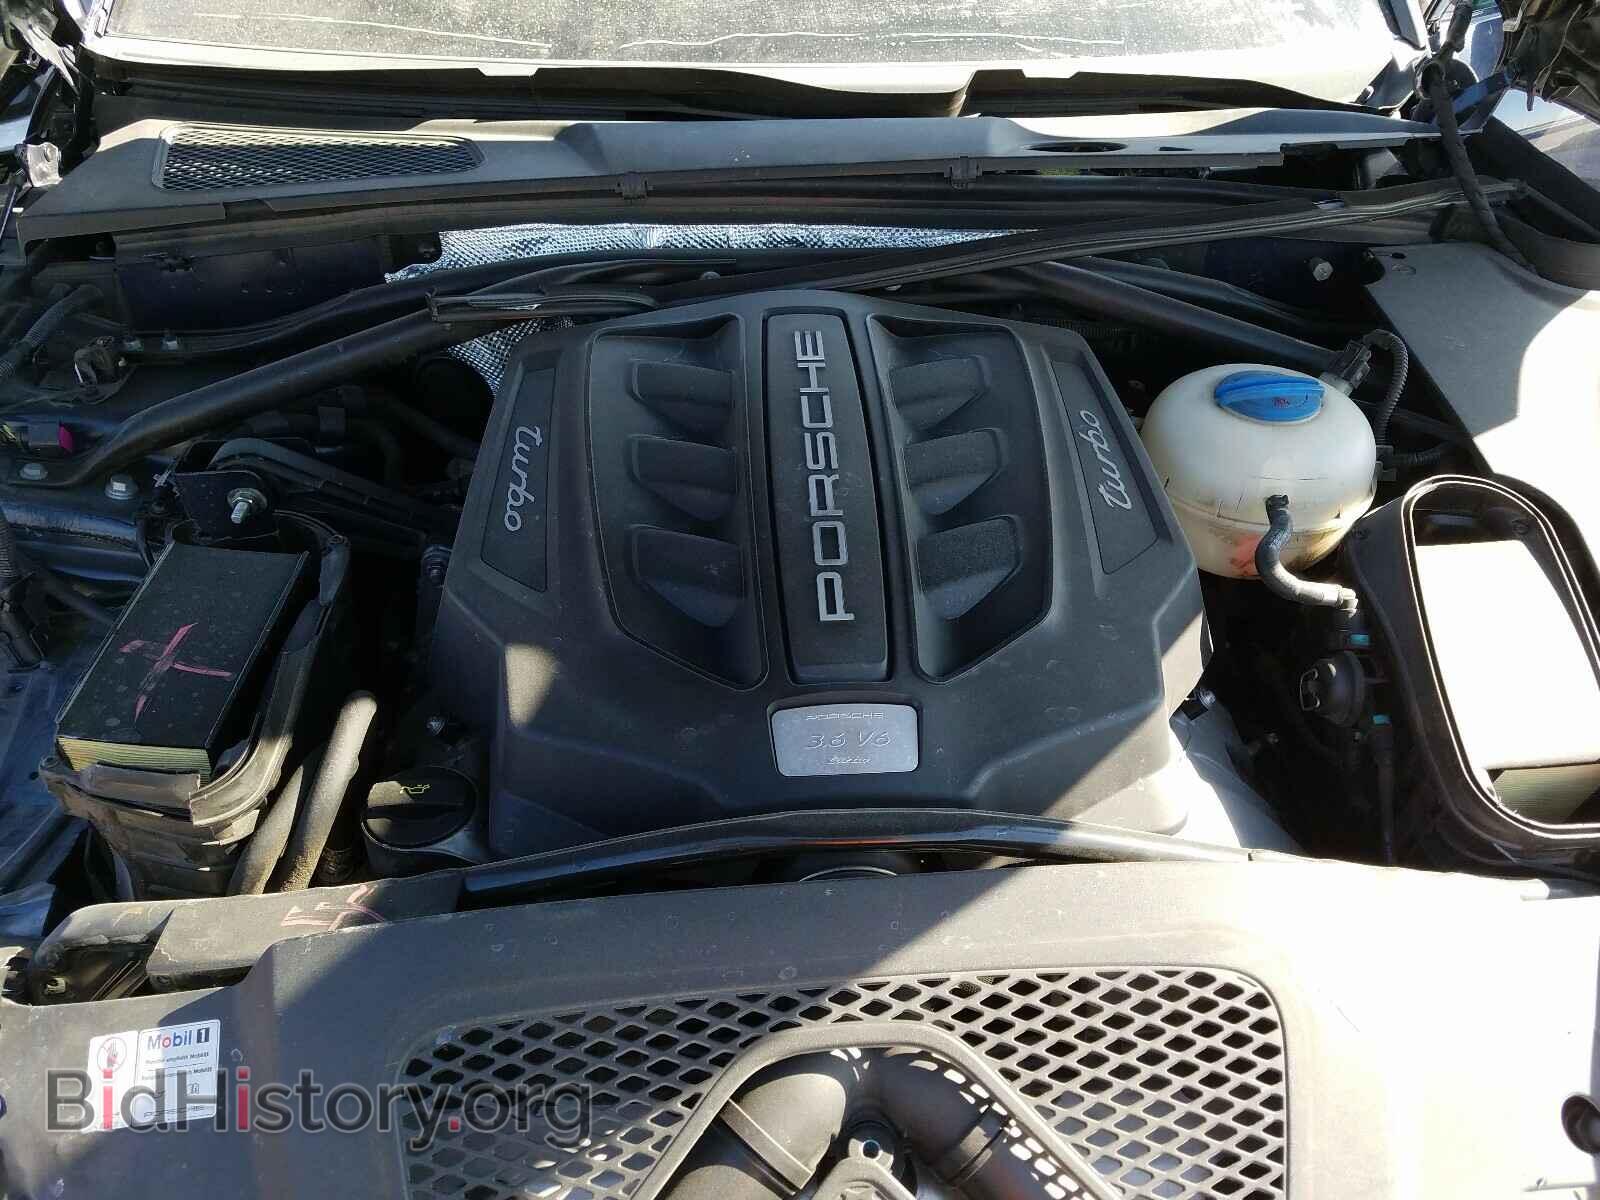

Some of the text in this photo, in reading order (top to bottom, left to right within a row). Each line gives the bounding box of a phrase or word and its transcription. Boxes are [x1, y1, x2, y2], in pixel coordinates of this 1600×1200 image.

[794, 330, 855, 621] PORSCHE
[858, 729, 892, 748] V6
[147, 1028, 209, 1049] Mobil 1
